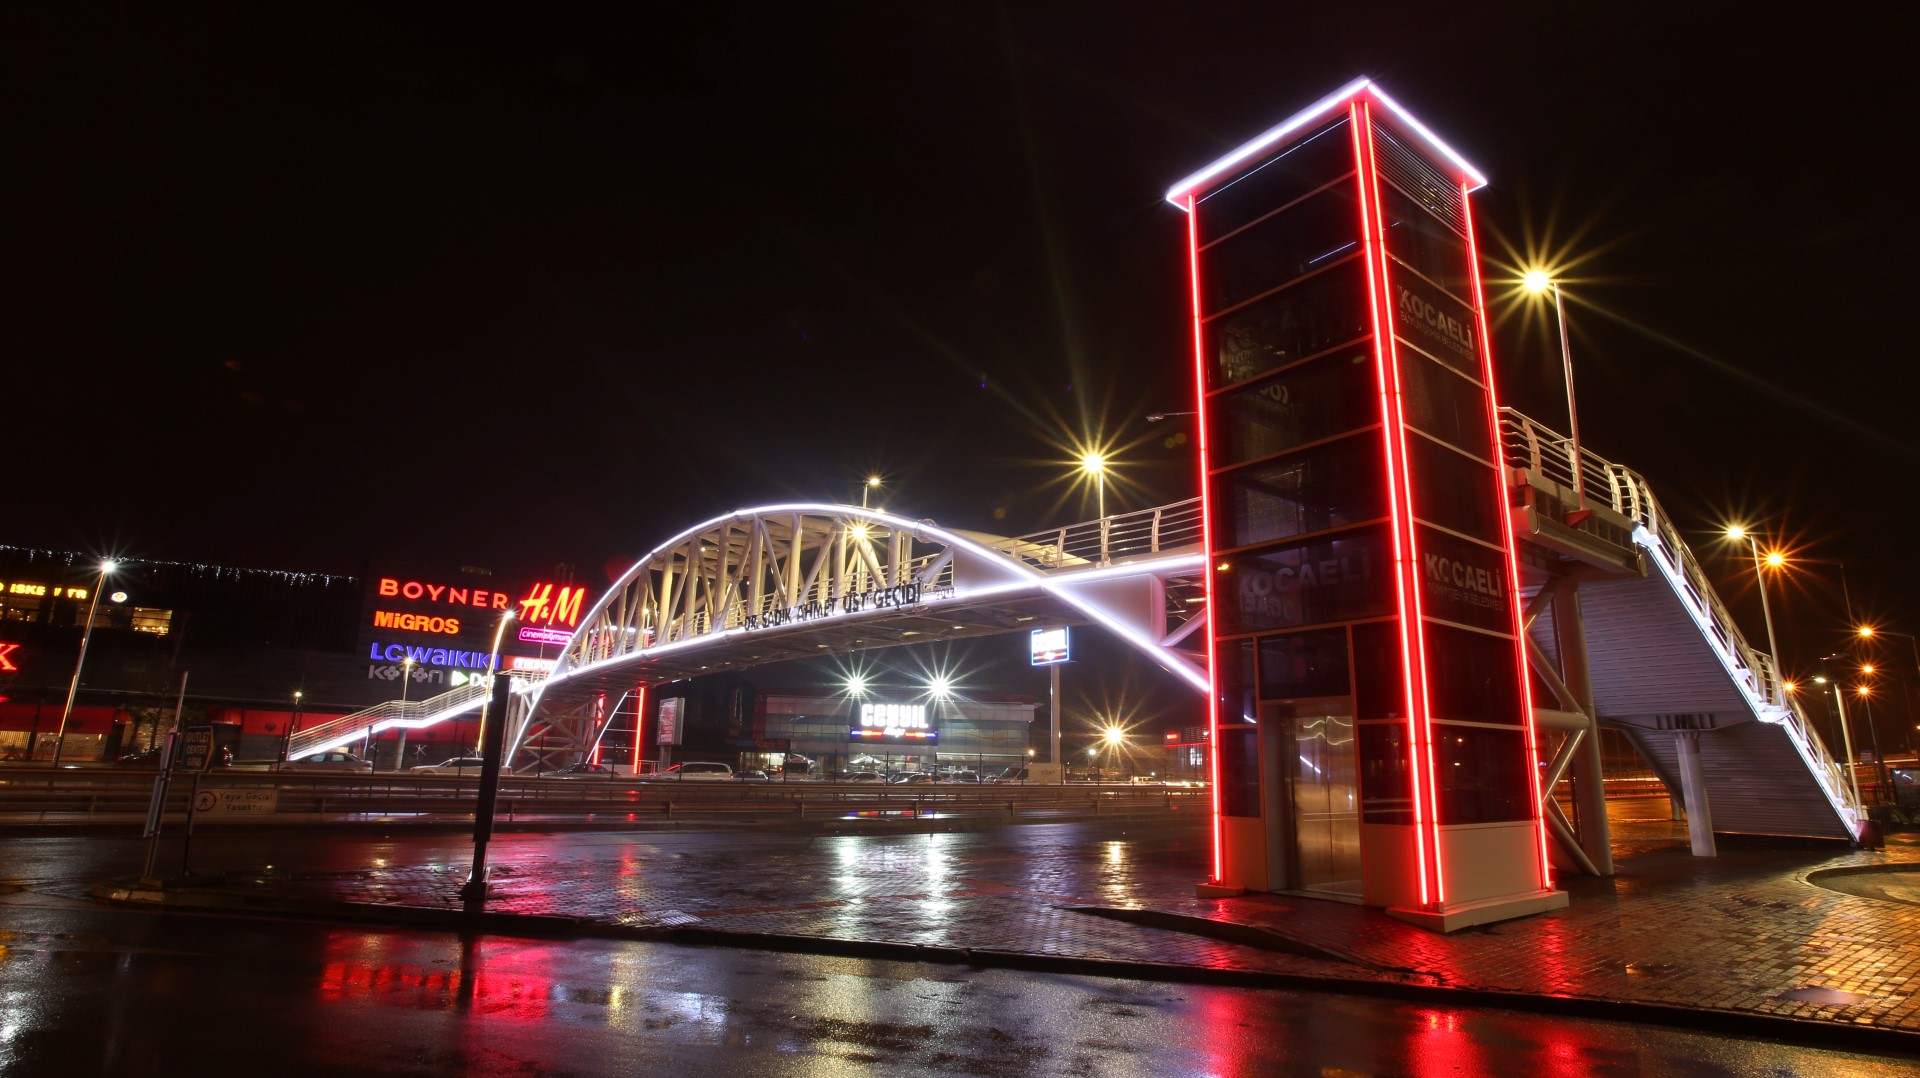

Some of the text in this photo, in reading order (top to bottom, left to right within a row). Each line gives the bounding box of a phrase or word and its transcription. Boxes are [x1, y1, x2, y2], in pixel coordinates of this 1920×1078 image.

[379, 578, 509, 609] BOYNER
[519, 582, 585, 627] H&M
[797, 597, 837, 621] AHMET
[843, 591, 868, 613] ÜST
[187, 731, 210, 743] OUTLET
[219, 791, 241, 802] Yaya
